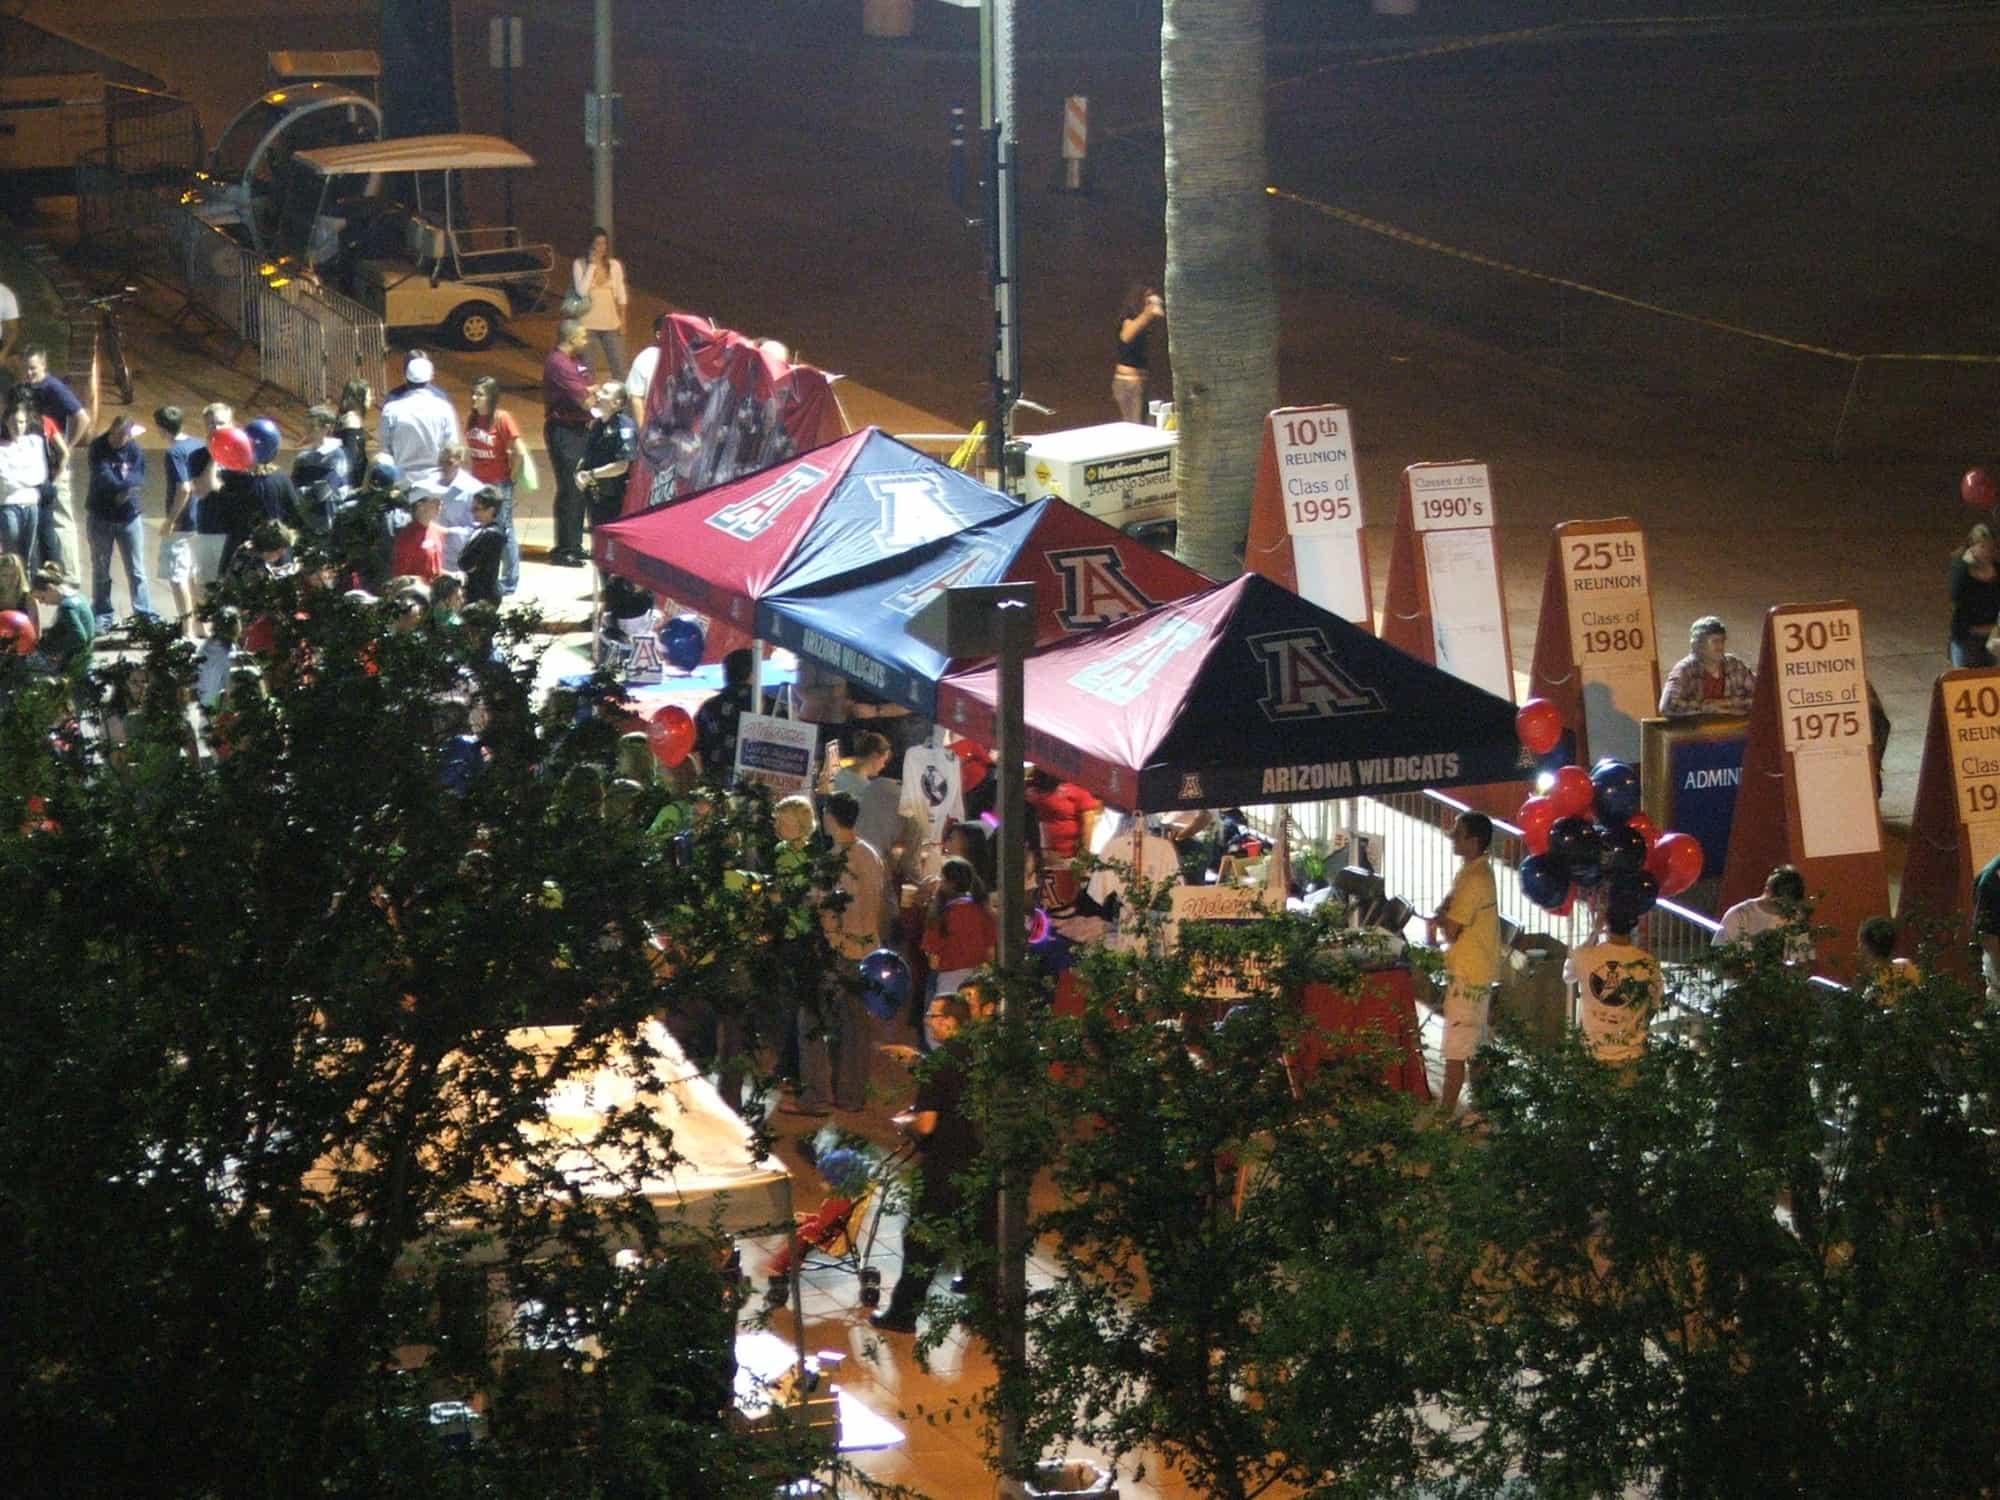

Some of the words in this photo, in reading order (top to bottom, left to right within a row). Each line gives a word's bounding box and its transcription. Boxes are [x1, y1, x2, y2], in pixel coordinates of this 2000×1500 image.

[1283, 416, 1338, 447] 10th
[1285, 449, 1347, 465] REUNION
[1288, 476, 1329, 496] Class
[1334, 473, 1350, 492] of
[704, 463, 831, 541] A
[1292, 497, 1351, 524] 1995
[1423, 497, 1484, 519] 1990's
[1571, 541, 1636, 571] 25th
[1044, 544, 1165, 632] A
[1574, 575, 1641, 591] REUNION
[1581, 611, 1620, 627] Class
[1624, 609, 1640, 625] of
[1583, 627, 1645, 653] 1980
[1784, 619, 1852, 653] 30th
[1247, 627, 1386, 721] A
[1785, 658, 1856, 677] REUNION
[1787, 687, 1833, 707] Class
[1842, 684, 1857, 702] of
[1791, 711, 1860, 741] 1975
[1262, 763, 1352, 794] ARIZONA
[1358, 752, 1460, 784] WILDCATS
